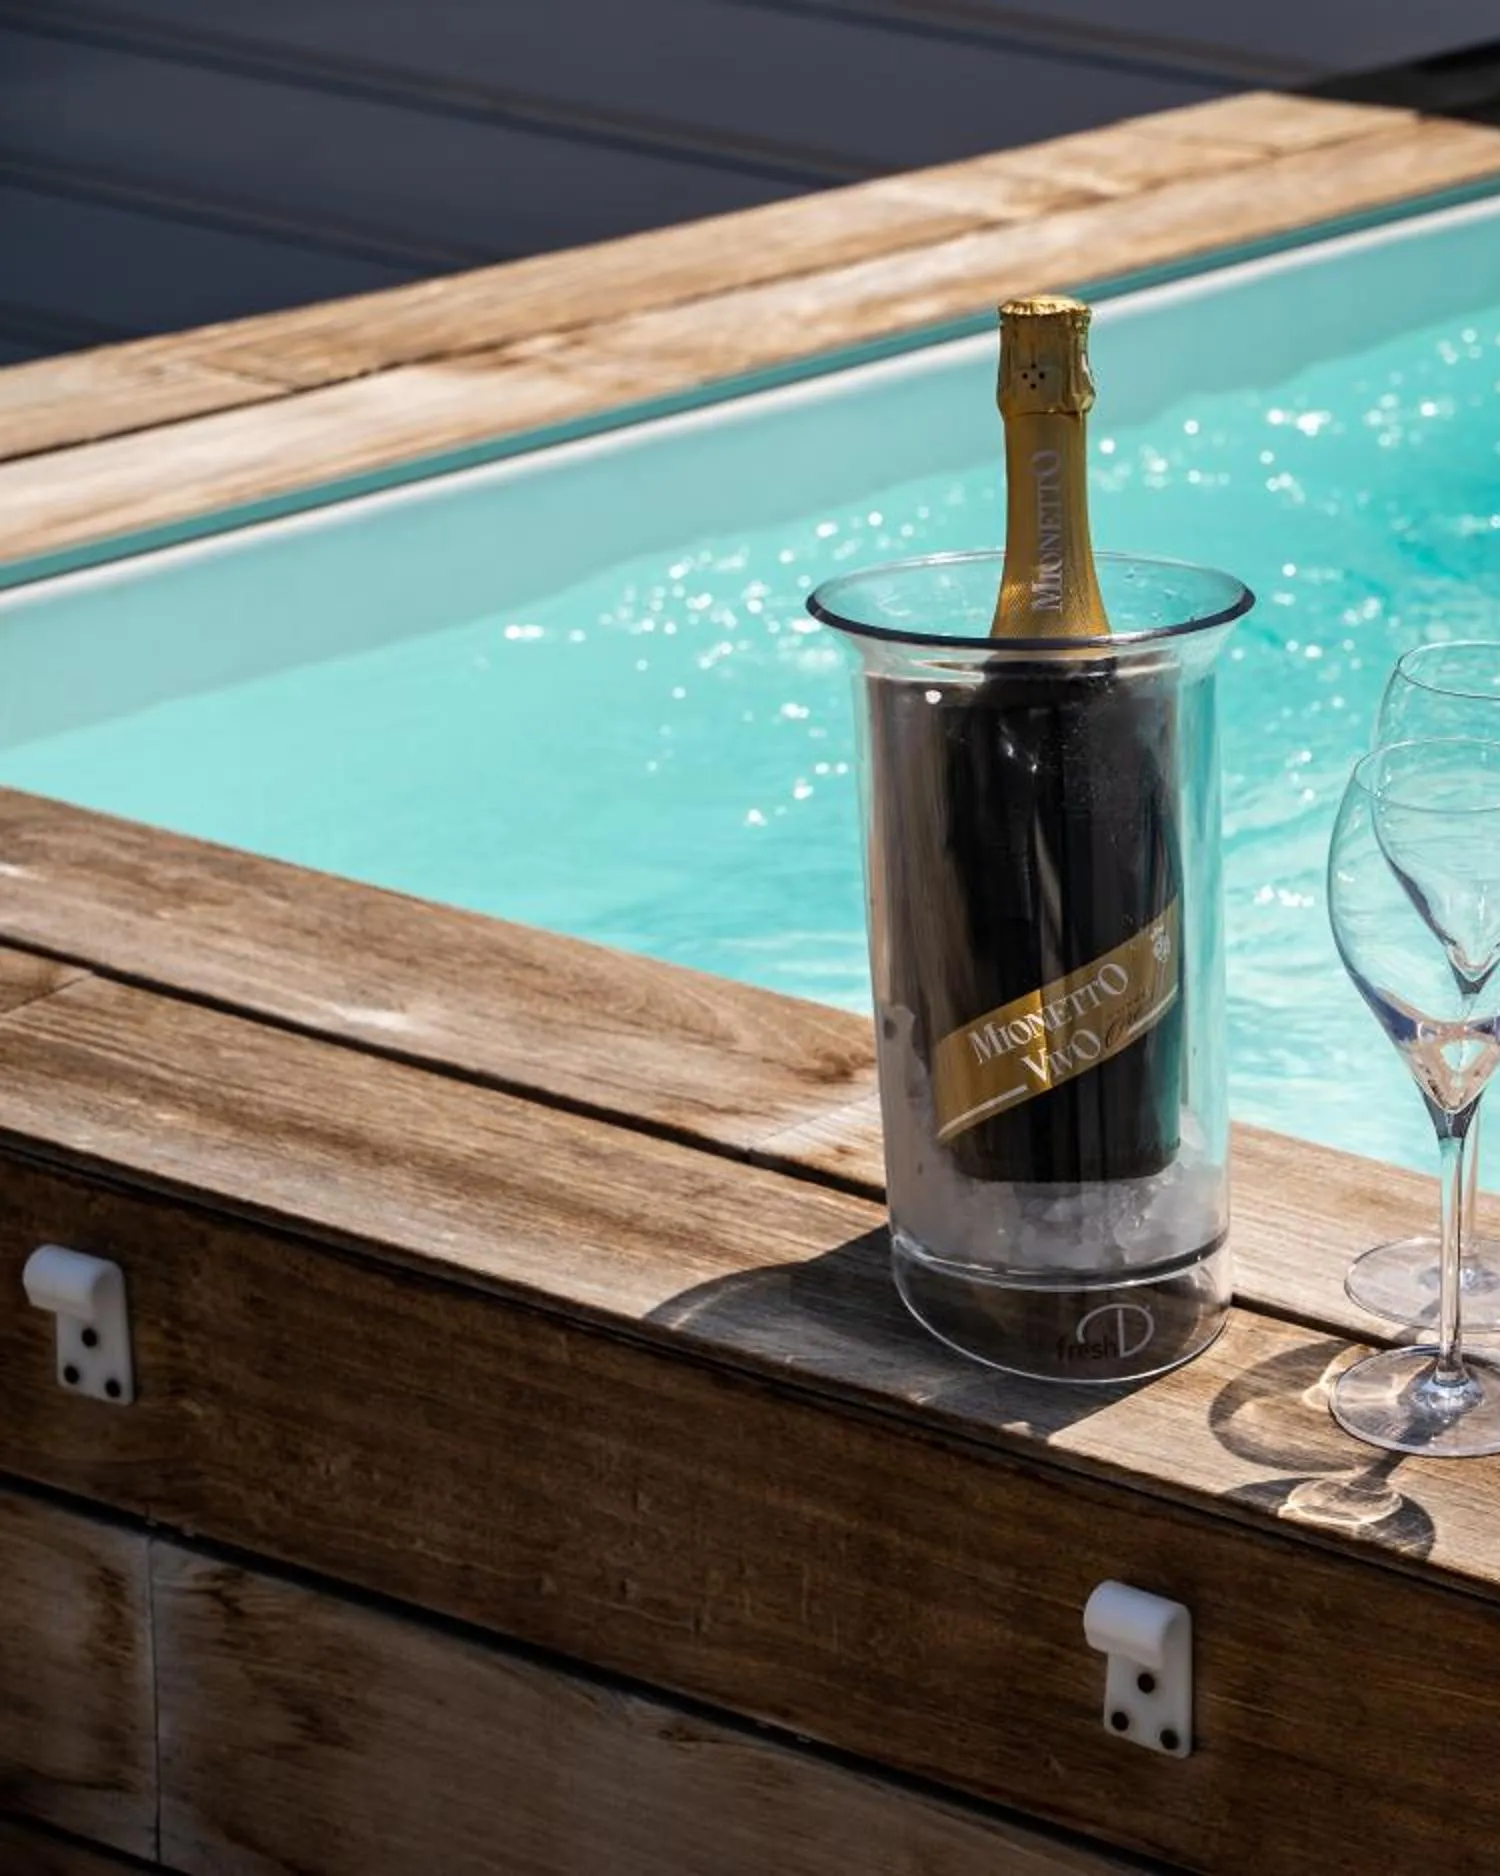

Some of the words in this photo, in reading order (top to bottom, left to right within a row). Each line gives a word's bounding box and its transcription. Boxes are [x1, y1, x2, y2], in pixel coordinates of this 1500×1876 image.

[1031, 451, 1064, 613] MIONETTO
[968, 962, 1129, 1066] MIONETTO
[1021, 1028, 1102, 1083] VIVO
